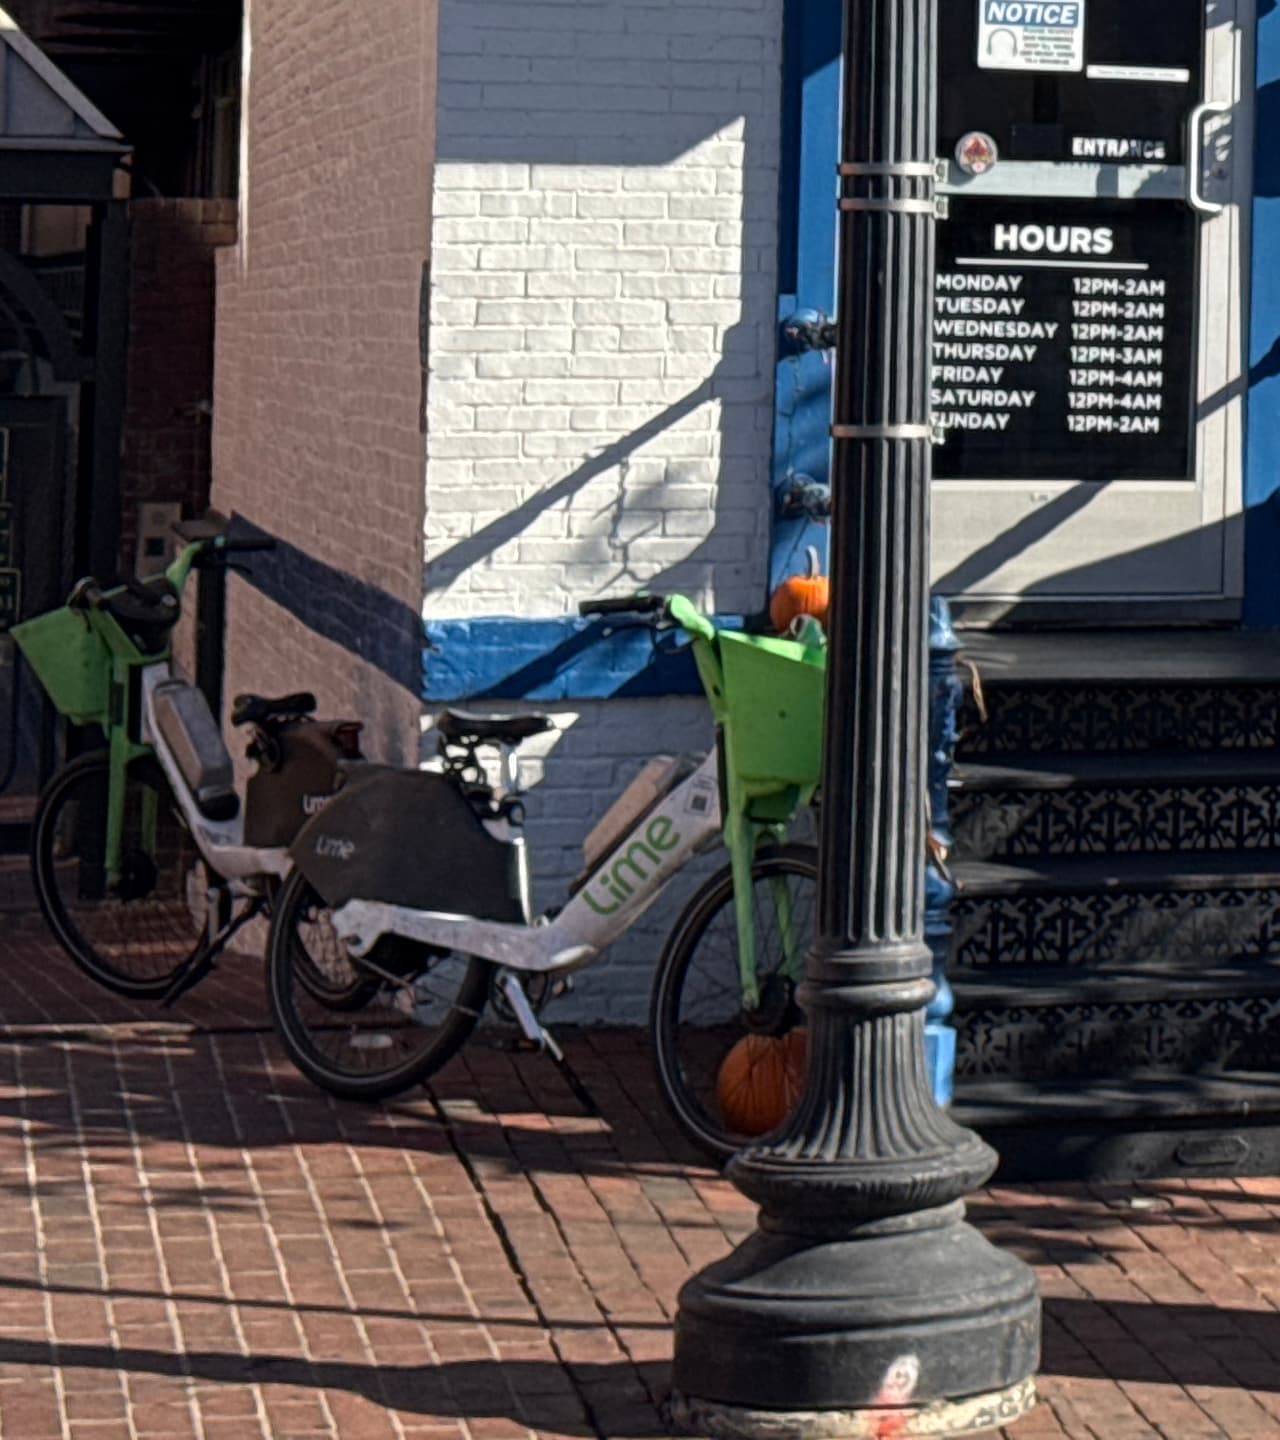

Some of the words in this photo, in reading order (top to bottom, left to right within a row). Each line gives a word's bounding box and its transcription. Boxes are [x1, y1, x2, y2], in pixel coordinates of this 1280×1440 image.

[987, 1, 1077, 25] NOTICE
[1072, 136, 1166, 159] ENTRANCE
[994, 223, 1114, 255] HOURS
[935, 273, 1023, 292] MONDAY
[1073, 277, 1166, 296] 12PM-2AM
[935, 296, 1026, 315] TUESDAY
[1072, 300, 1165, 319] 12PM-2AM
[933, 319, 1058, 339] WEDNESDAY
[1071, 323, 1164, 342] 12PM-2AM
[933, 342, 1037, 362] THURSDAY
[1070, 345, 1163, 365] 12PM-3AM
[931, 365, 1004, 384] FRIDAY
[1069, 369, 1163, 388] 12PM-4AM
[930, 388, 1036, 407] SATURDAY
[1068, 391, 1161, 410] 12PM-4AM
[930, 411, 1011, 430] SUNDAY
[1067, 414, 1160, 434] 12PM-2AM
[582, 815, 681, 915] Lime
